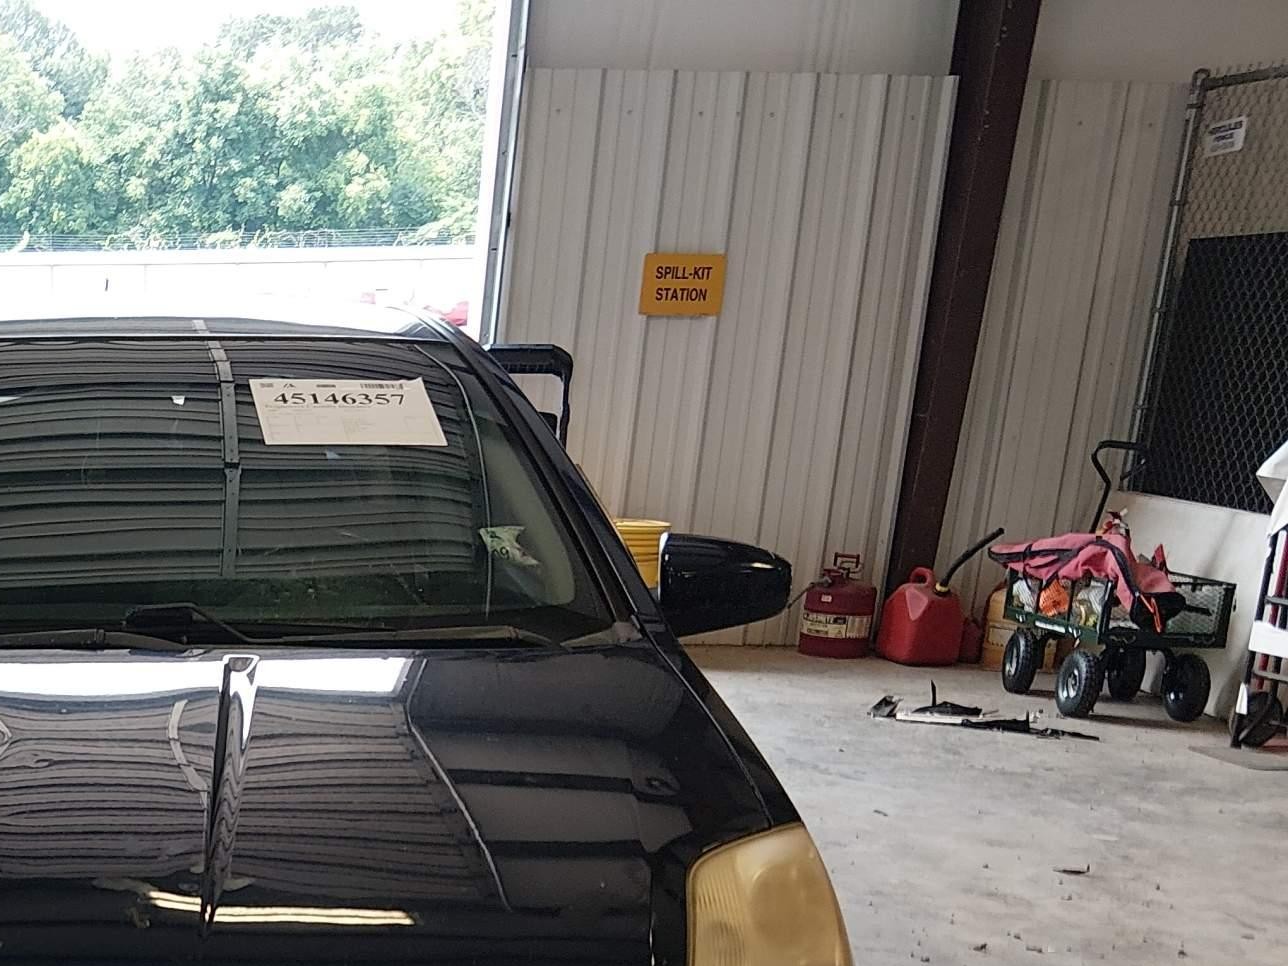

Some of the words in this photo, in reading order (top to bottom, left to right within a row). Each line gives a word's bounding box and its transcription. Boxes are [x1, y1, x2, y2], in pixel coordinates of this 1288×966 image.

[655, 265, 713, 281] SPILL-KIT
[655, 287, 708, 302] STATION
[274, 392, 405, 406] 45146357
